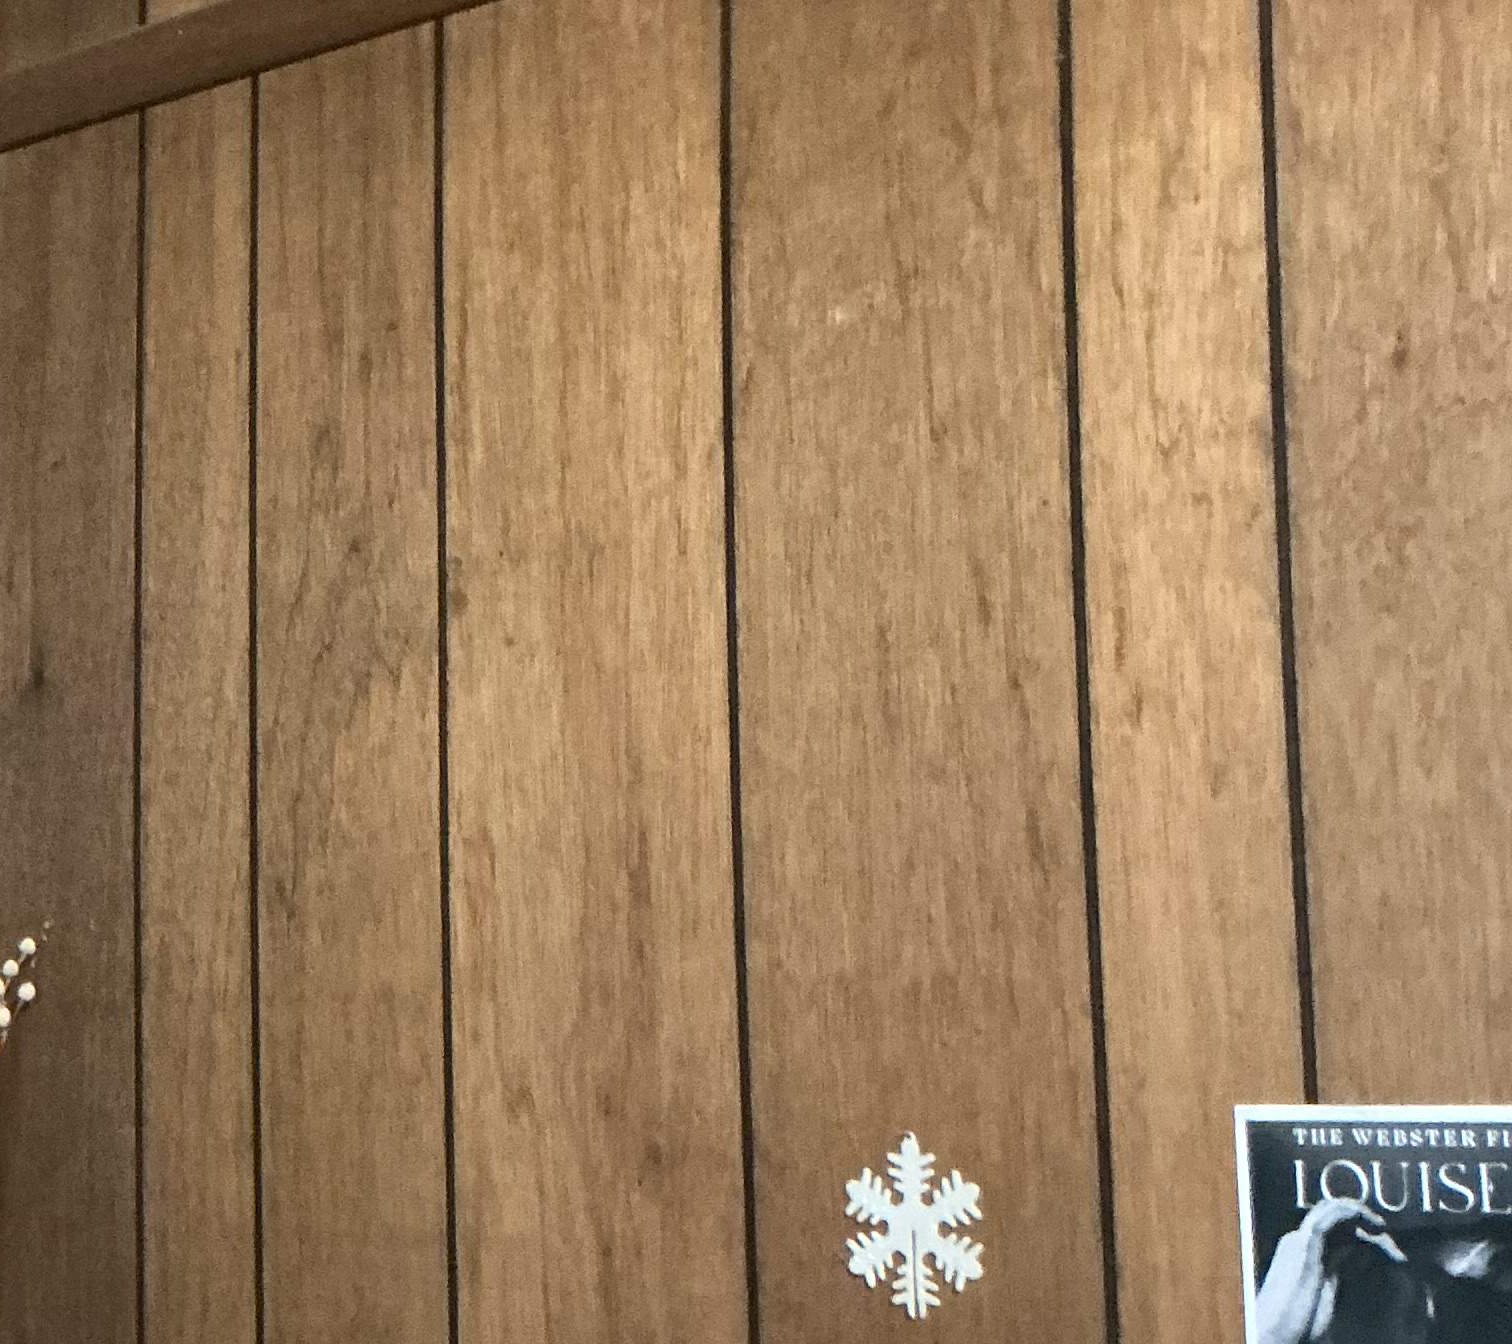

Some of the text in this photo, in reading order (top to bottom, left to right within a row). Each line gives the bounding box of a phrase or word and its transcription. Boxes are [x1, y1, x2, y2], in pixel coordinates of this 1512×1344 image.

[1292, 1127, 1344, 1147] THE
[1351, 1127, 1477, 1148] WEBSTER
[1292, 1158, 1512, 1215] LOUISE
